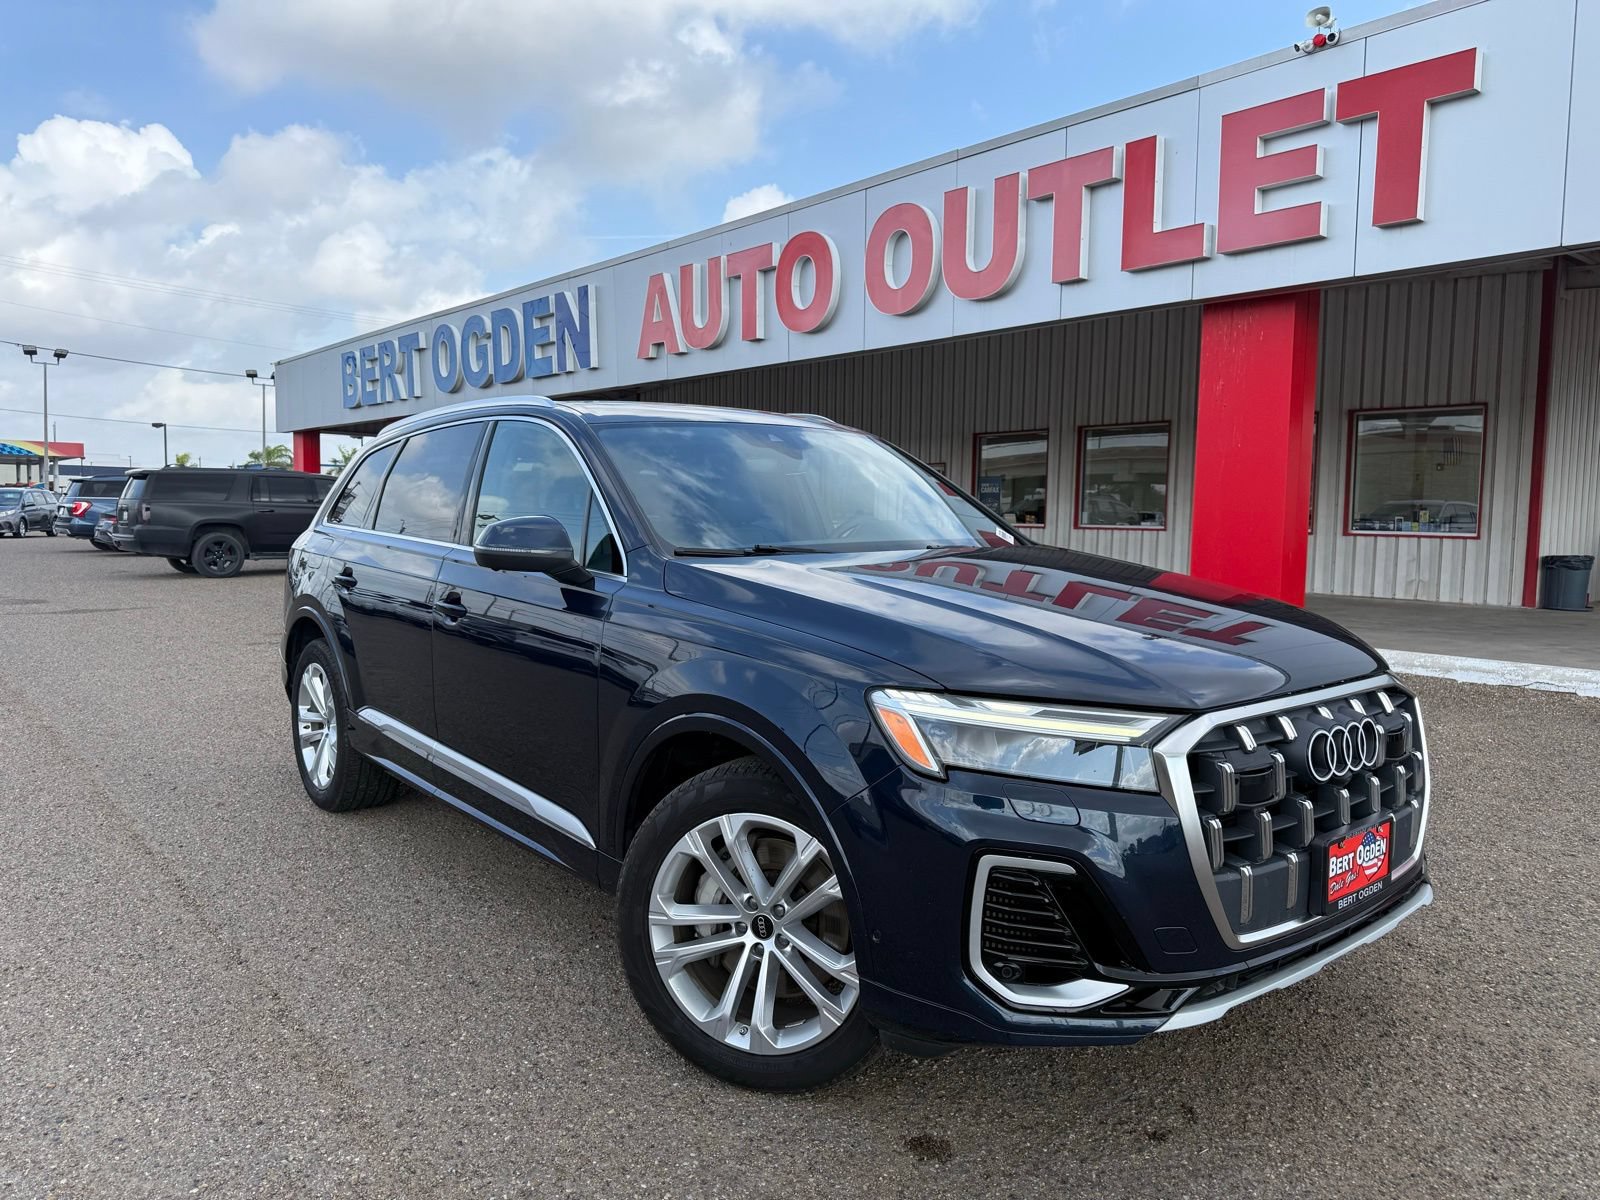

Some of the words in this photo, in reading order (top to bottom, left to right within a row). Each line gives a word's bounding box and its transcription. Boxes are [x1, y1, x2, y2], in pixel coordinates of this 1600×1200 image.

[341, 331, 427, 409] BERT
[431, 284, 599, 394] OGDEN
[637, 231, 842, 360] AUTO
[865, 47, 1482, 316] OUTLET
[1329, 852, 1355, 878] BERT
[1356, 837, 1387, 865] OGDEN
[1338, 894, 1357, 909] BERT
[1358, 881, 1383, 900] OGDEN
